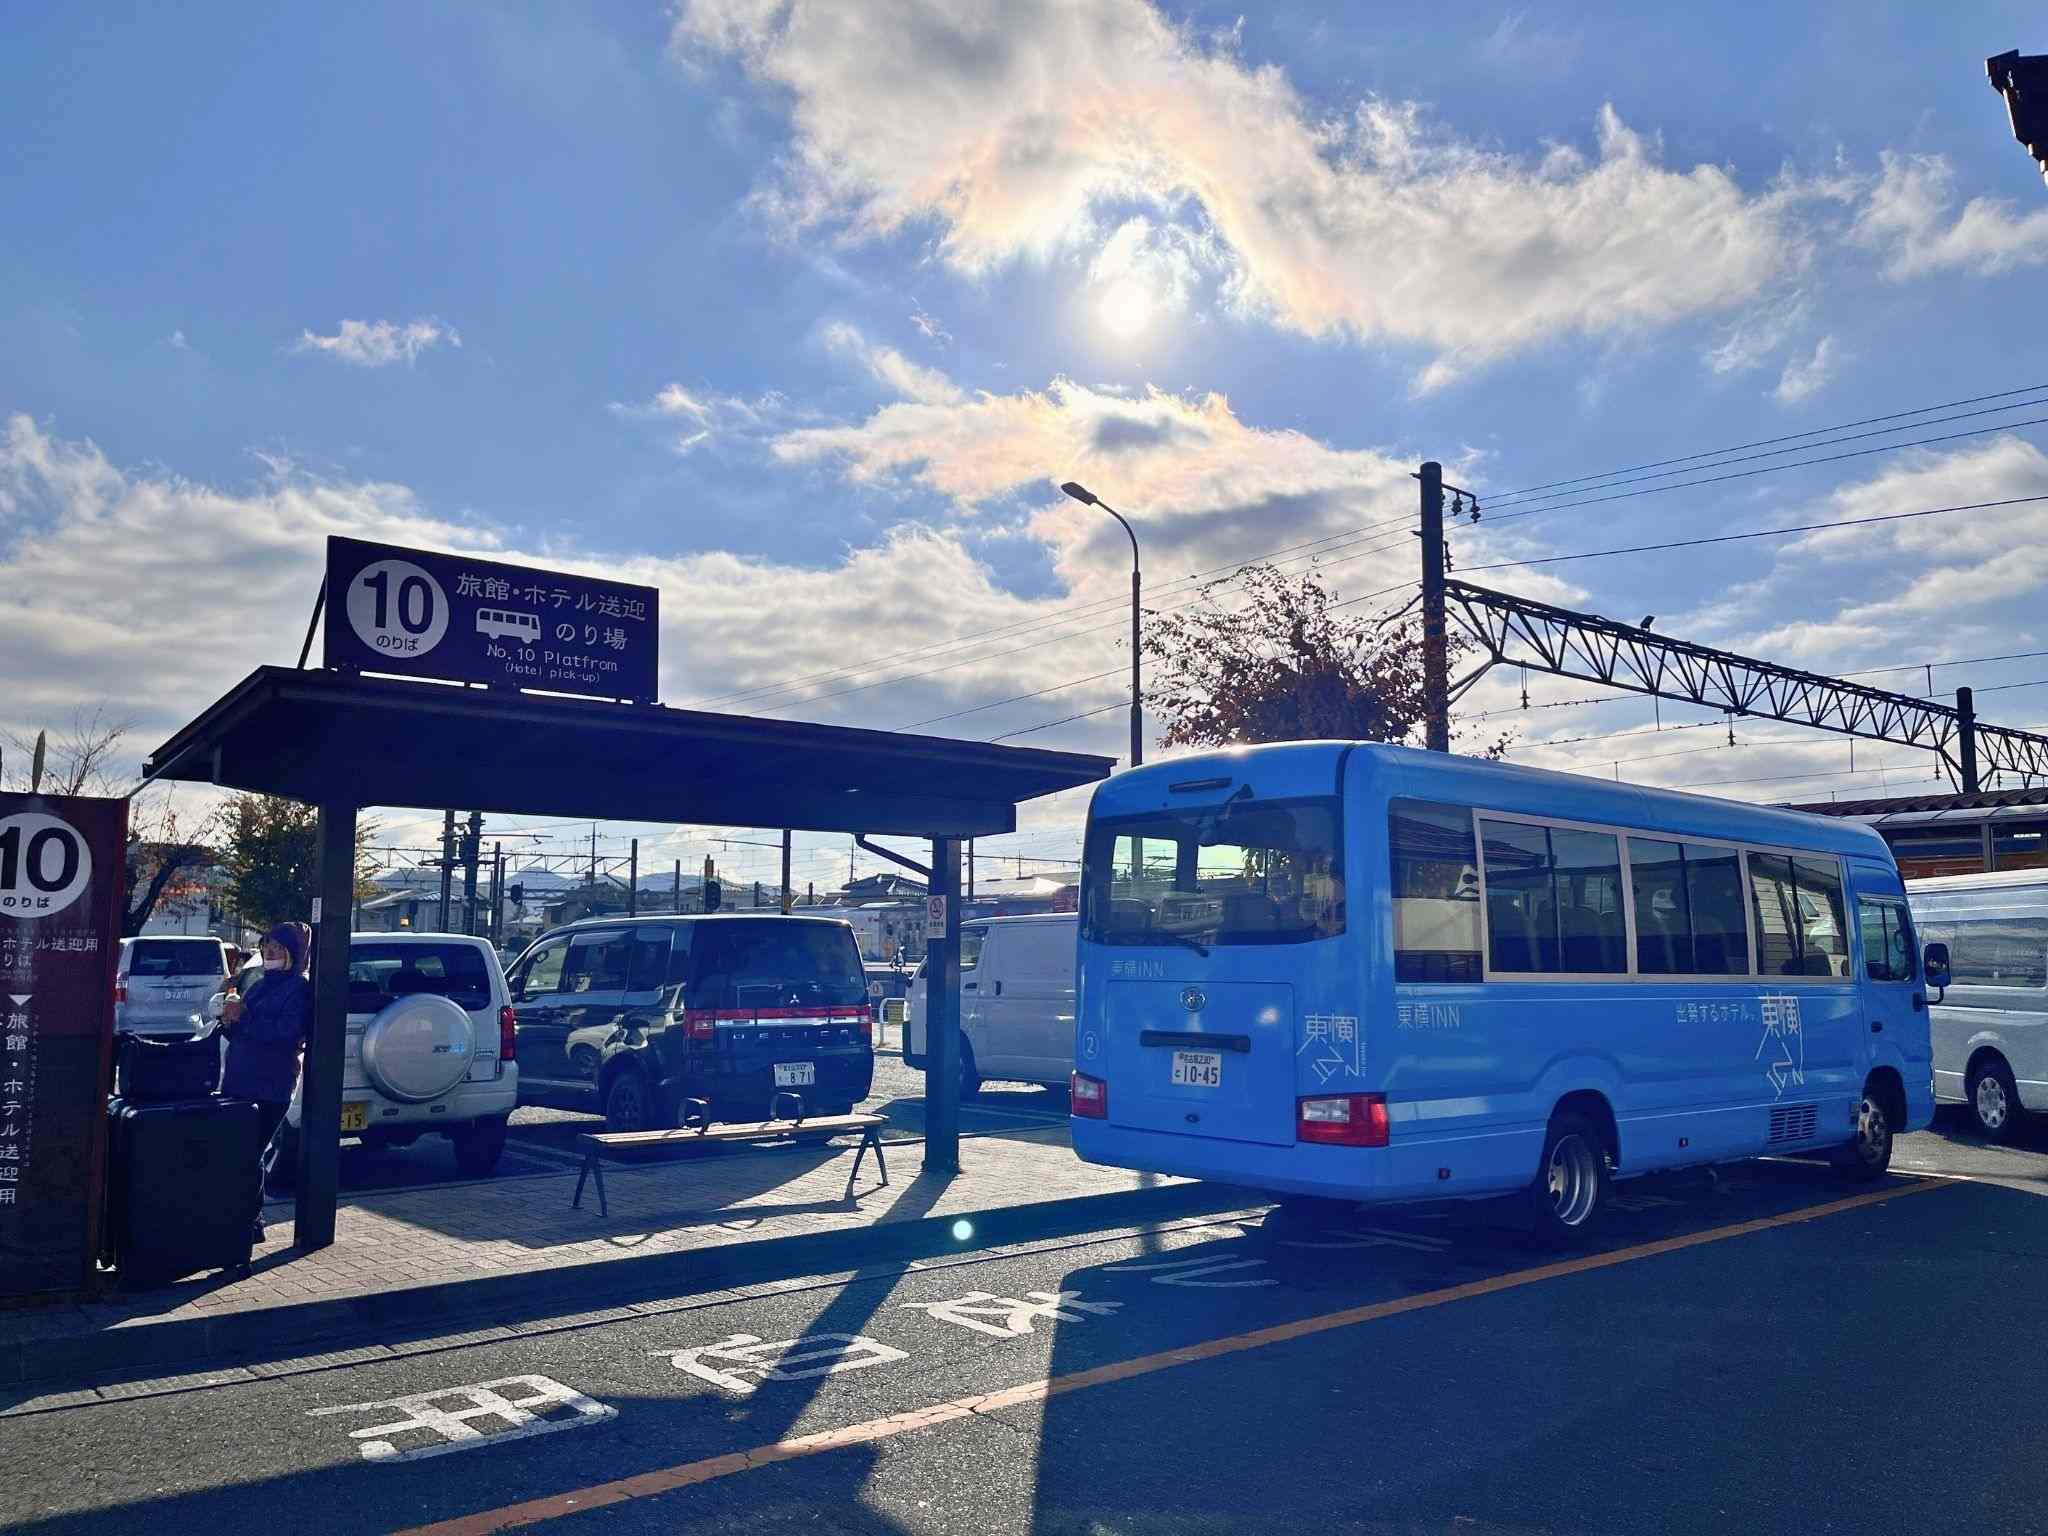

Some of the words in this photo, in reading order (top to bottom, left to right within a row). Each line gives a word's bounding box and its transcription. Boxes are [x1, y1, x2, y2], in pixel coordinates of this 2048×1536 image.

[363, 570, 434, 634] 10
[455, 572, 647, 622] 旅館・ホテル送迎
[376, 634, 420, 652] のりば
[555, 621, 628, 651] のり場
[505, 661, 542, 676] (Hotel
[517, 647, 535, 662] 10
[543, 650, 618, 672] Platfrom
[0, 826, 80, 893] 10
[3, 896, 50, 908] のりば
